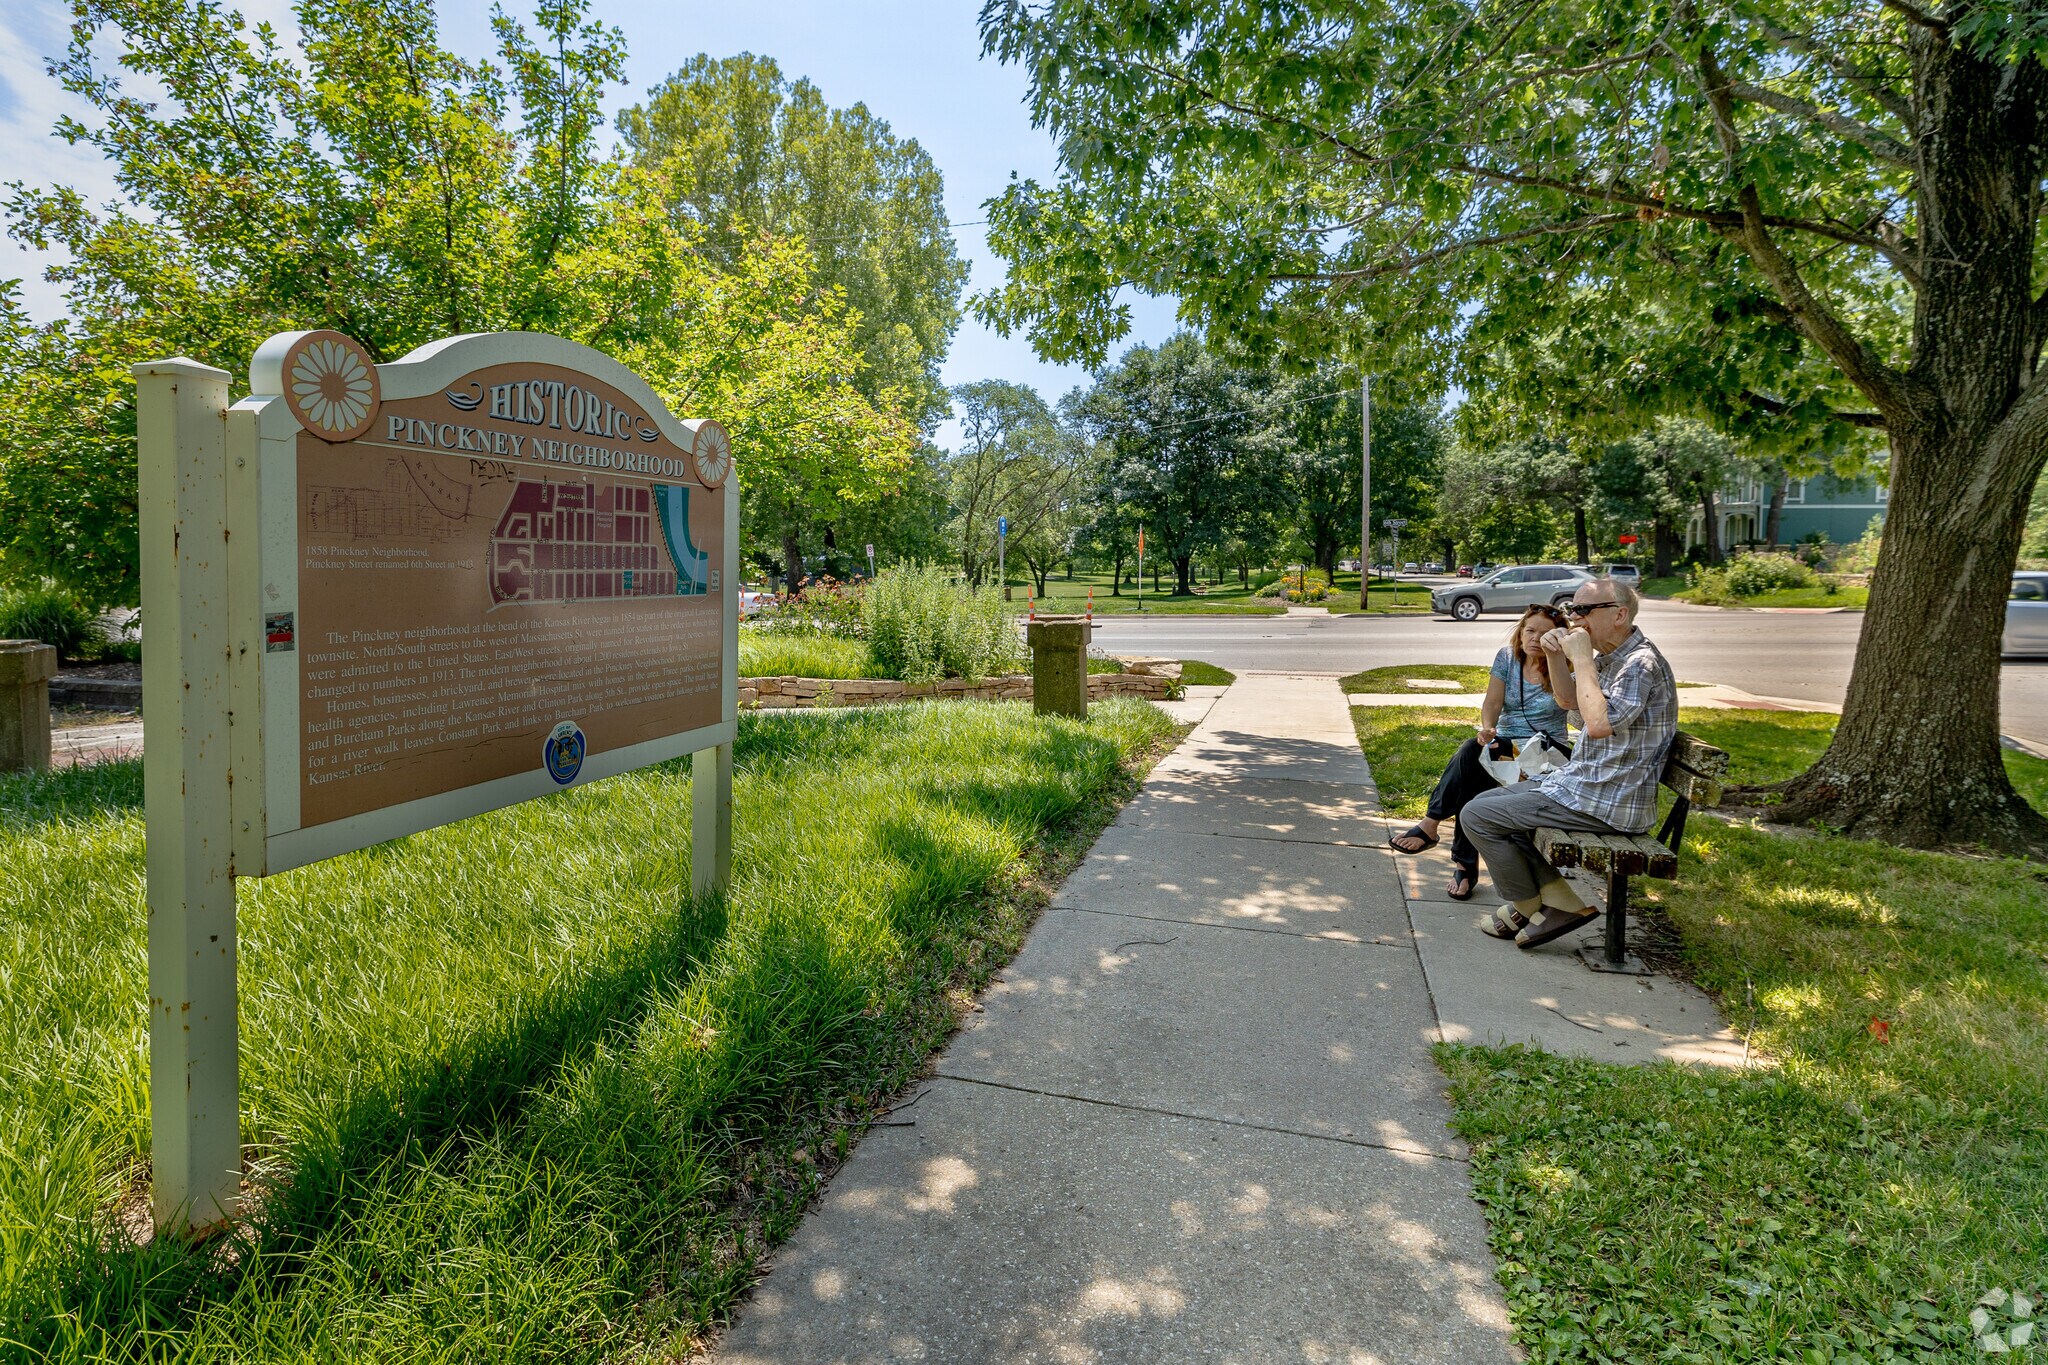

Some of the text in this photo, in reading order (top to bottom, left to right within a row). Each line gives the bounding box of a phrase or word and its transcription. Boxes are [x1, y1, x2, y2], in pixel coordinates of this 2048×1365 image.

[489, 380, 632, 440] HISTORIC
[387, 415, 526, 457] PINCKNEY
[531, 437, 685, 477] NEIGHBORHOOD
[305, 559, 455, 570] Pinckney Street renamed 6th Street in
[306, 546, 429, 558] 1858 Pinckney Neighborhood.
[307, 648, 359, 663] townsite.
[363, 641, 426, 658] North/South
[429, 640, 459, 652] streets
[461, 639, 470, 649] to
[472, 637, 486, 648] the
[488, 636, 507, 646] west
[509, 634, 519, 644] of
[521, 631, 573, 643] Massachusetts
[603, 625, 624, 636] named
[626, 625, 634, 634] for
[636, 624, 652, 633] states
[653, 623, 659, 631] in
[660, 622, 669, 631] the
[670, 621, 684, 630] order
[685, 620, 691, 628] in
[692, 618, 707, 628] which
[708, 618, 718, 627] they
[326, 631, 348, 644] The
[352, 629, 400, 642] Pinckney
[404, 623, 469, 640] neighborhood
[472, 624, 480, 633] at
[483, 622, 495, 632] the
[498, 620, 517, 631] bend
[520, 619, 528, 630] of
[530, 619, 542, 629] the
[544, 618, 570, 628] Kansas
[572, 616, 592, 626] River
[591, 615, 610, 626] began
[612, 614, 619, 623] in
[621, 612, 635, 622] 1854
[644, 612, 655, 622] part
[656, 611, 663, 619] of
[664, 610, 673, 619] the
[674, 609, 693, 619] original
[695, 608, 718, 616] Lawrence
[307, 669, 336, 681] were
[341, 660, 388, 677] admitted
[393, 661, 403, 671] to
[407, 658, 422, 670] the
[427, 654, 458, 667] United
[494, 647, 533, 660] East/West
[565, 640, 596, 654] originally
[600, 638, 622, 649] named
[623, 637, 633, 646] for
[307, 680, 355, 698] changed
[358, 681, 369, 692] to
[372, 675, 416, 690] numbers
[418, 673, 428, 684] in
[431, 669, 456, 682] 1913.
[459, 667, 475, 679] The
[478, 664, 509, 676] modern
[511, 657, 562, 673] neighborhood
[564, 655, 572, 666] of
[573, 654, 592, 664] about
[612, 649, 638, 660] residents
[639, 646, 661, 656] extends
[668, 644, 681, 653] Iowa
[488, 678, 502, 690] and
[538, 673, 556, 683] were
[558, 667, 584, 680] located
[585, 666, 592, 676] in
[593, 665, 603, 675] the
[605, 662, 632, 673] Pinckney
[677, 653, 692, 663] Today
[693, 651, 708, 660] social
[709, 649, 718, 658] and
[307, 715, 343, 733] health
[402, 702, 447, 718] including
[451, 696, 494, 710] Lawrence
[498, 687, 536, 702] Memorial
[538, 682, 569, 696] Hospital
[572, 680, 585, 691] mix
[588, 677, 602, 688] with
[605, 676, 625, 685] homes
[627, 673, 633, 682] in
[635, 671, 644, 681] the
[662, 667, 677, 676] Three
[696, 661, 718, 671] Constant
[307, 735, 329, 750] and
[333, 728, 383, 746] Burcham
[387, 721, 415, 736] Parks
[418, 718, 445, 731] along
[448, 714, 461, 726] the
[465, 710, 495, 723] Kansas
[498, 705, 519, 717] River
[521, 701, 535, 713] and
[538, 698, 565, 710] Clinton
[567, 693, 583, 704] Park
[585, 691, 603, 701] along
[605, 687, 615, 698] 5th
[628, 682, 650, 696] provide
[651, 682, 665, 691] open
[683, 675, 694, 684] The
[695, 672, 705, 682] trail
[706, 670, 718, 680] head
[308, 755, 325, 768] for
[342, 748, 368, 761] river
[374, 739, 398, 755] walk
[404, 736, 434, 749] leaves
[438, 726, 478, 742] Constant
[481, 720, 501, 734] Park
[504, 717, 519, 730] and
[522, 714, 541, 726] links
[544, 713, 551, 722] to
[555, 707, 586, 720] Burcham
[589, 702, 603, 713] Park
[606, 702, 613, 710] to
[615, 698, 640, 708] welcome
[644, 693, 664, 703] visitors
[666, 690, 674, 698] for
[676, 687, 692, 697] hiking
[694, 684, 708, 693] along
[309, 761, 386, 785] Kansas River.
